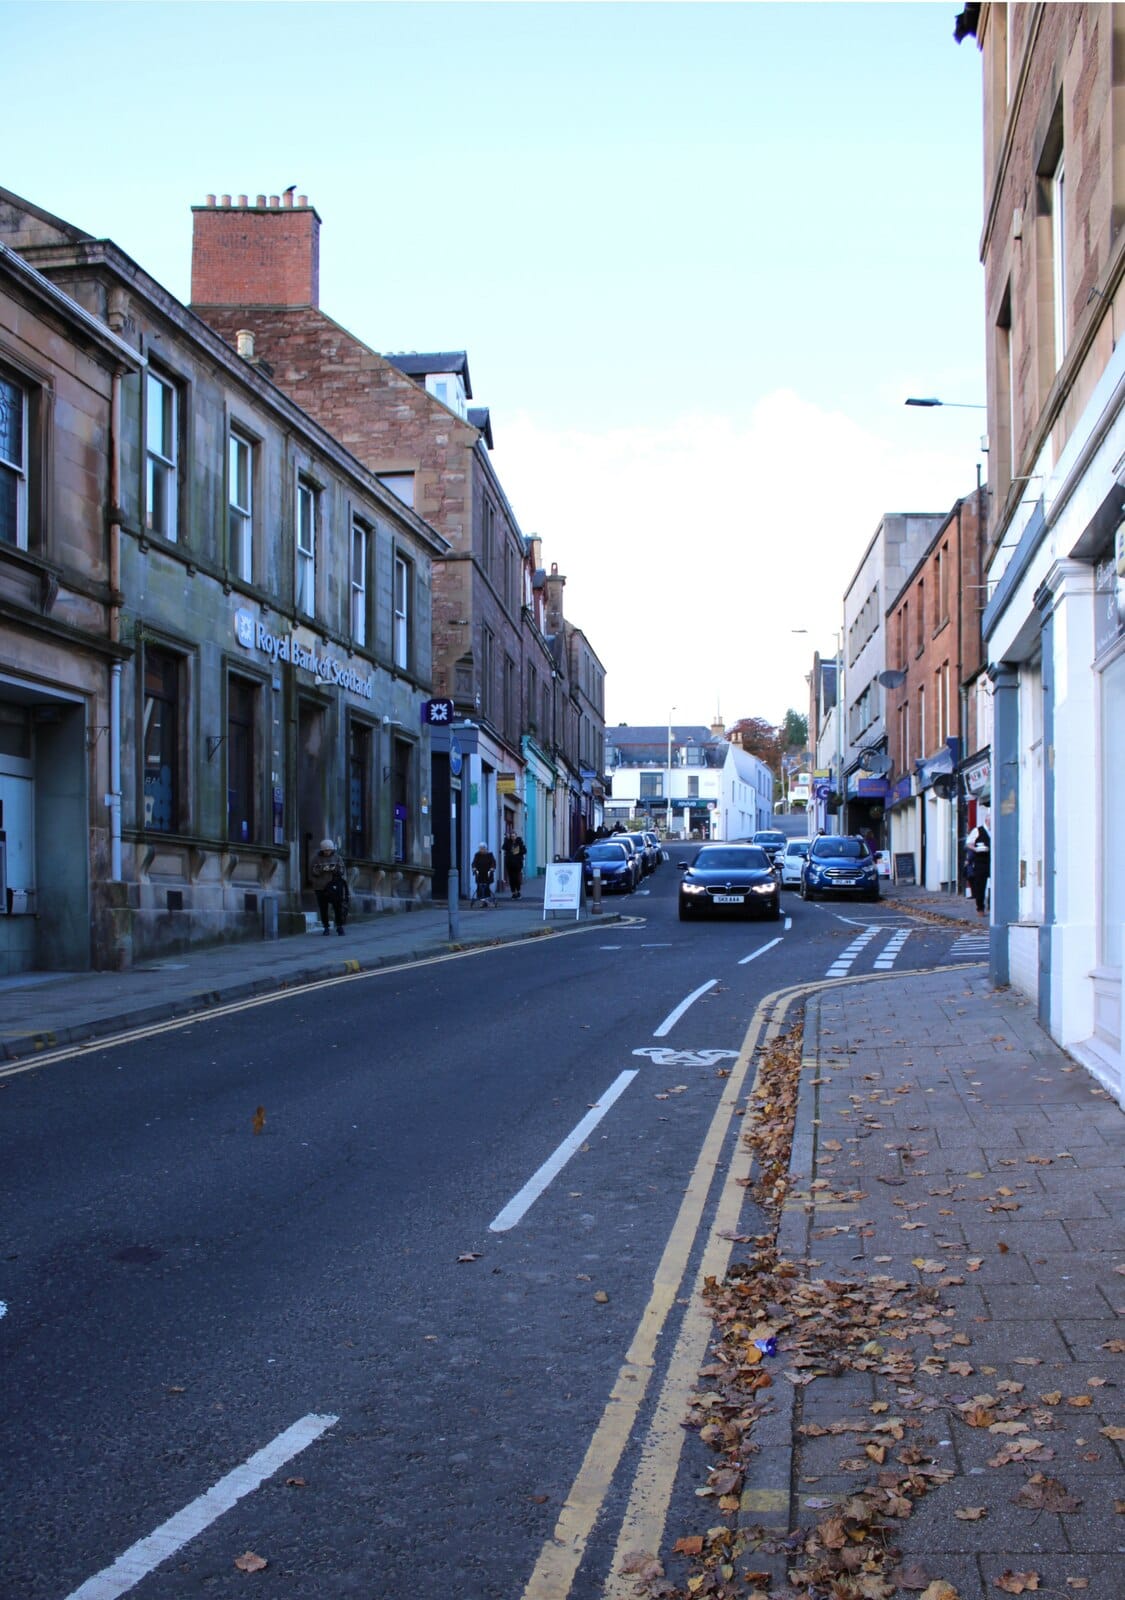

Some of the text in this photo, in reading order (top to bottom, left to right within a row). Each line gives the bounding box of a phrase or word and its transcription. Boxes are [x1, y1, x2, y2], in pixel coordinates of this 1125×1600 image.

[255, 621, 372, 698] Royal Bank of Scotland
